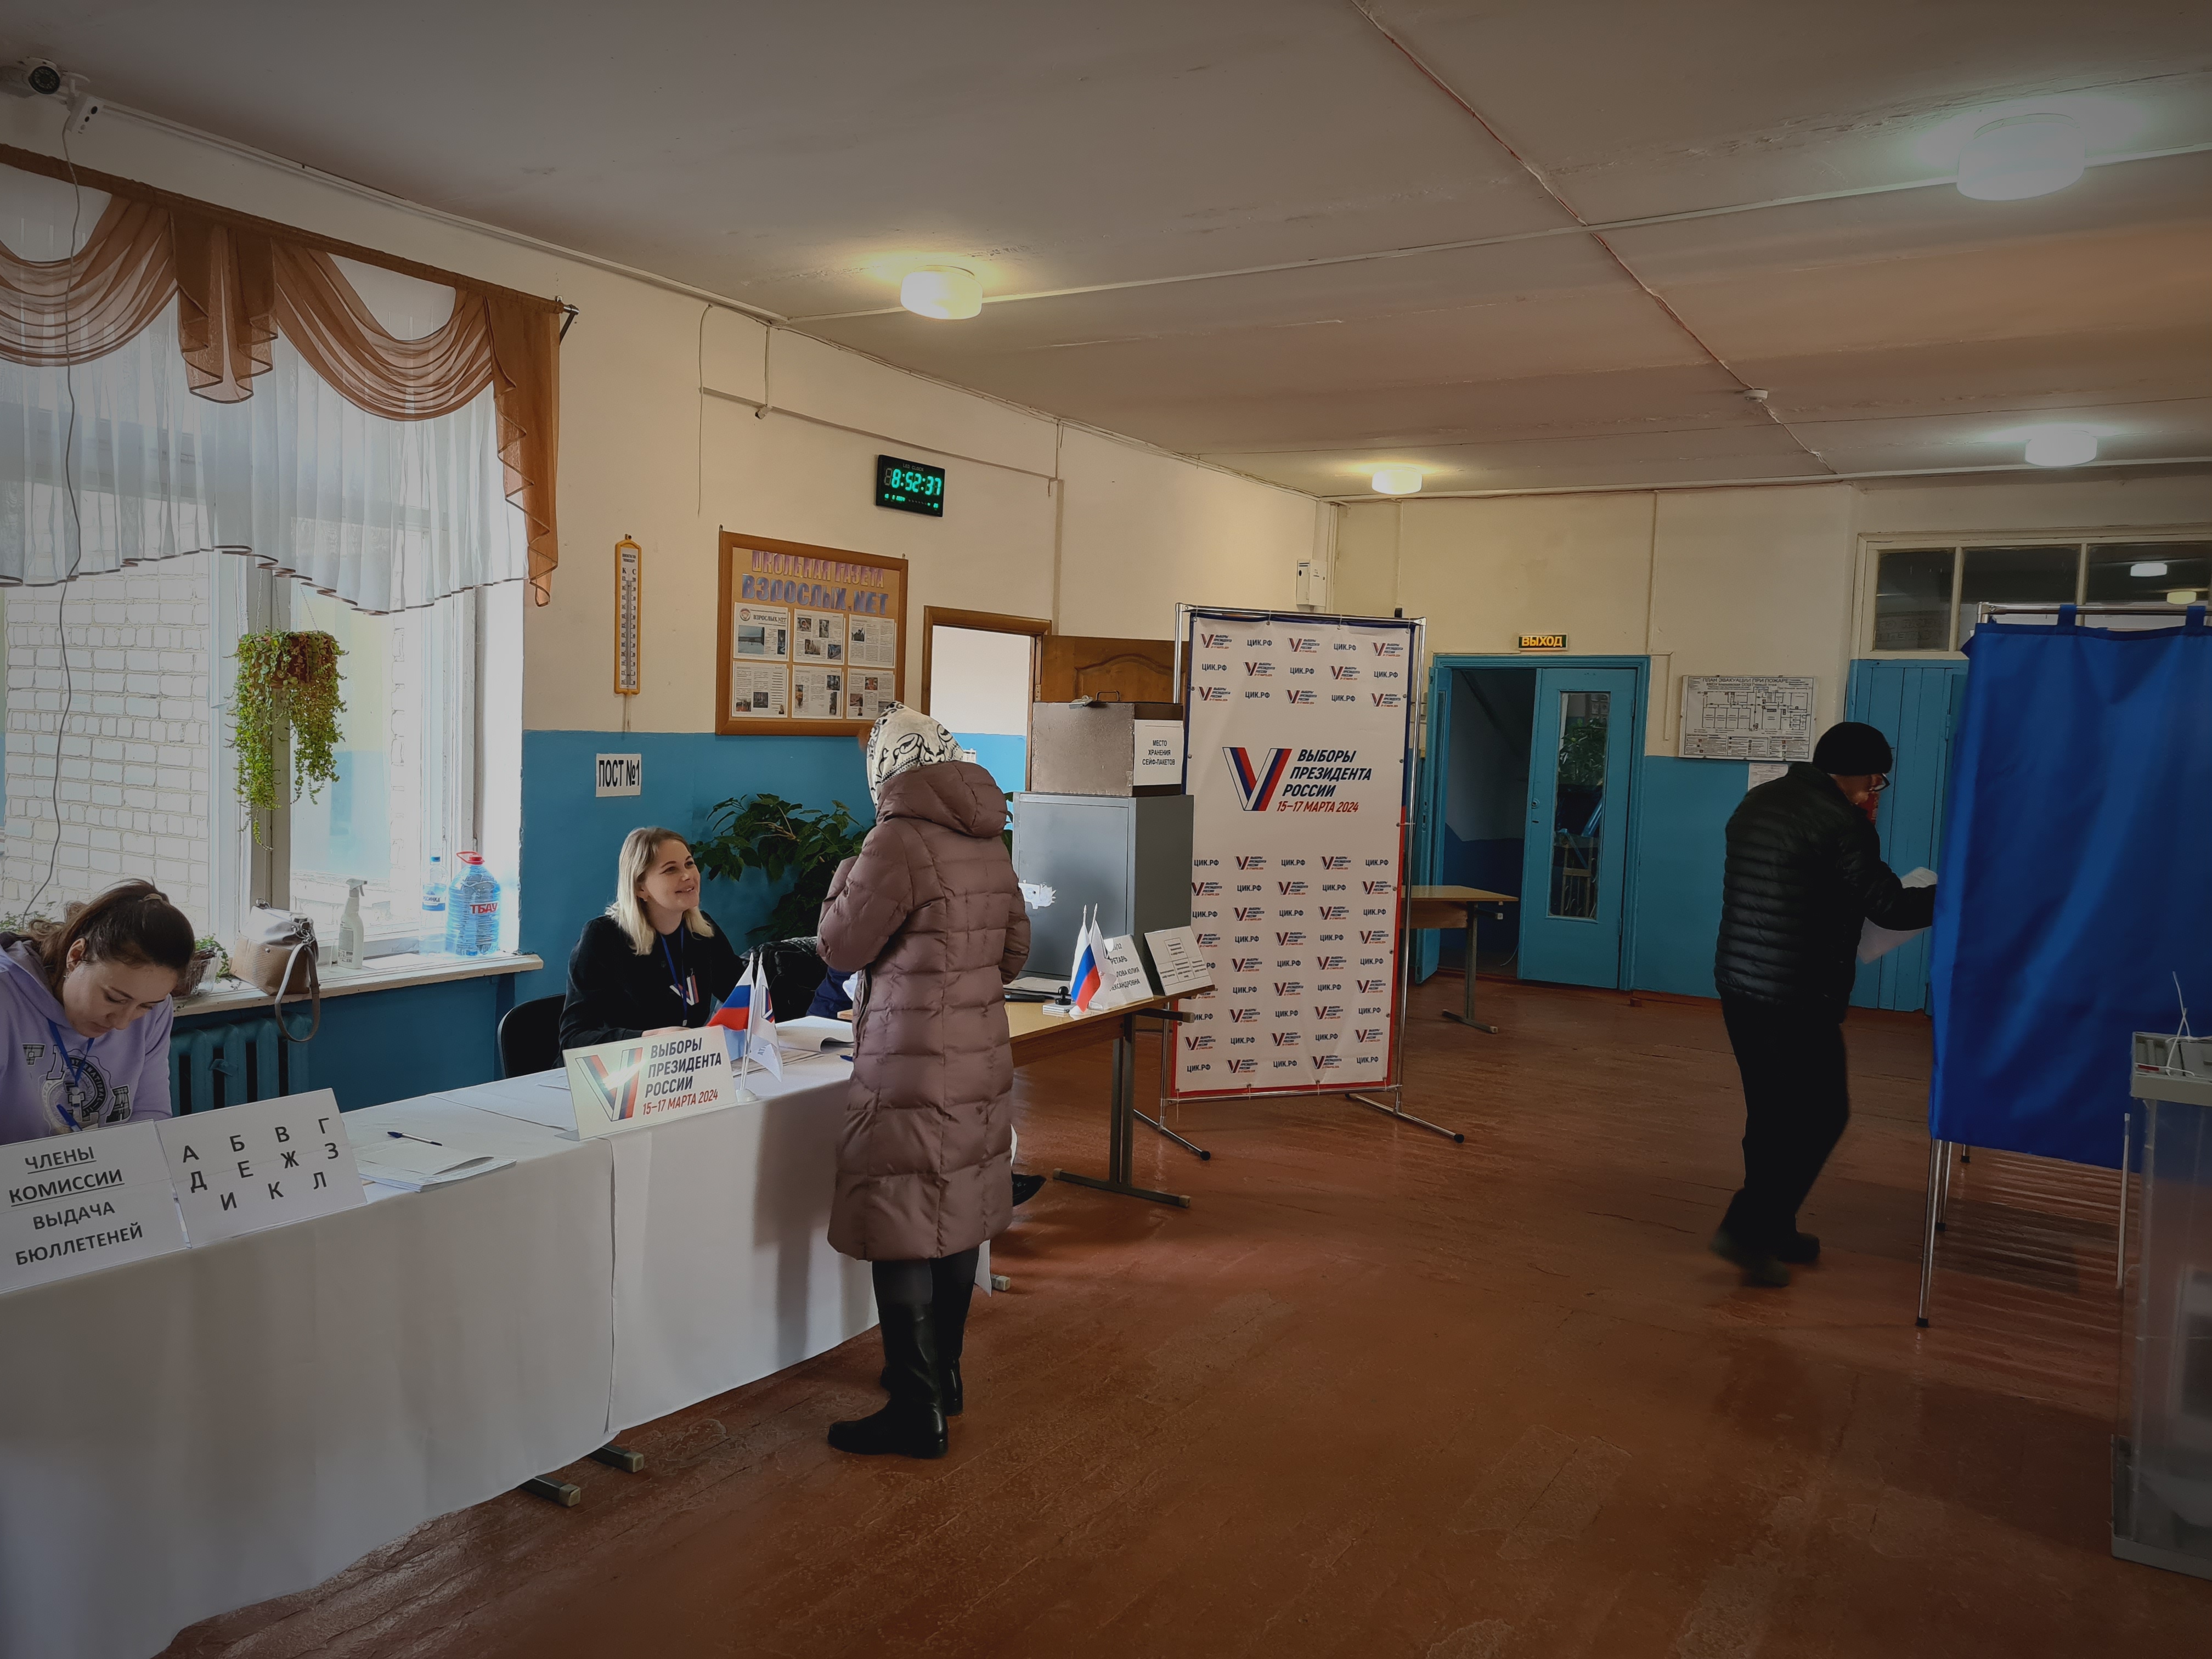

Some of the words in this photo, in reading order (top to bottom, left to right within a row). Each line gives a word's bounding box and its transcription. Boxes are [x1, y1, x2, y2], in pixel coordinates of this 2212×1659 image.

[752, 550, 831, 582] ШКОЛЬНАЯ
[835, 562, 884, 589] ГАЗЕТА
[1522, 636, 1562, 647] ВЫХОД
[1297, 749, 1356, 764] ВЫБОРЫ
[599, 760, 624, 787] ПОСТ
[626, 760, 639, 786] №1
[1289, 766, 1372, 781] ПРЕЗИДЕНТА
[1282, 784, 1336, 798] РОССИИ
[1306, 802, 1334, 813] МАРТА
[1336, 802, 1359, 813] 2024
[651, 1037, 702, 1059] ВЫБОРЫ
[648, 1052, 722, 1079] ПРЕЗИДЕНТА
[1187, 1064, 1210, 1073] ЦИК.РФ
[69, 1058, 105, 1103] NTRNATIONAL
[645, 1075, 693, 1098] РОССИИ
[667, 1093, 696, 1110] МАРТА
[698, 1089, 718, 1104] 2024
[182, 1145, 200, 1163] А
[229, 1135, 246, 1152] Б
[274, 1126, 290, 1143] В
[318, 1118, 330, 1133] Г
[24, 1146, 94, 1170] ЧЛЕНЫ
[190, 1171, 207, 1193] Д
[238, 1160, 253, 1178] Е
[280, 1150, 300, 1169] Ж
[325, 1142, 339, 1160] З
[9, 1169, 123, 1204] КОМИССИИ
[221, 1192, 237, 1211] И
[268, 1181, 284, 1200] К
[312, 1171, 327, 1189] Л
[32, 1201, 115, 1230] ВЫДАЧА
[15, 1222, 143, 1266] БЮЛЛЕТЕНЕЙ
